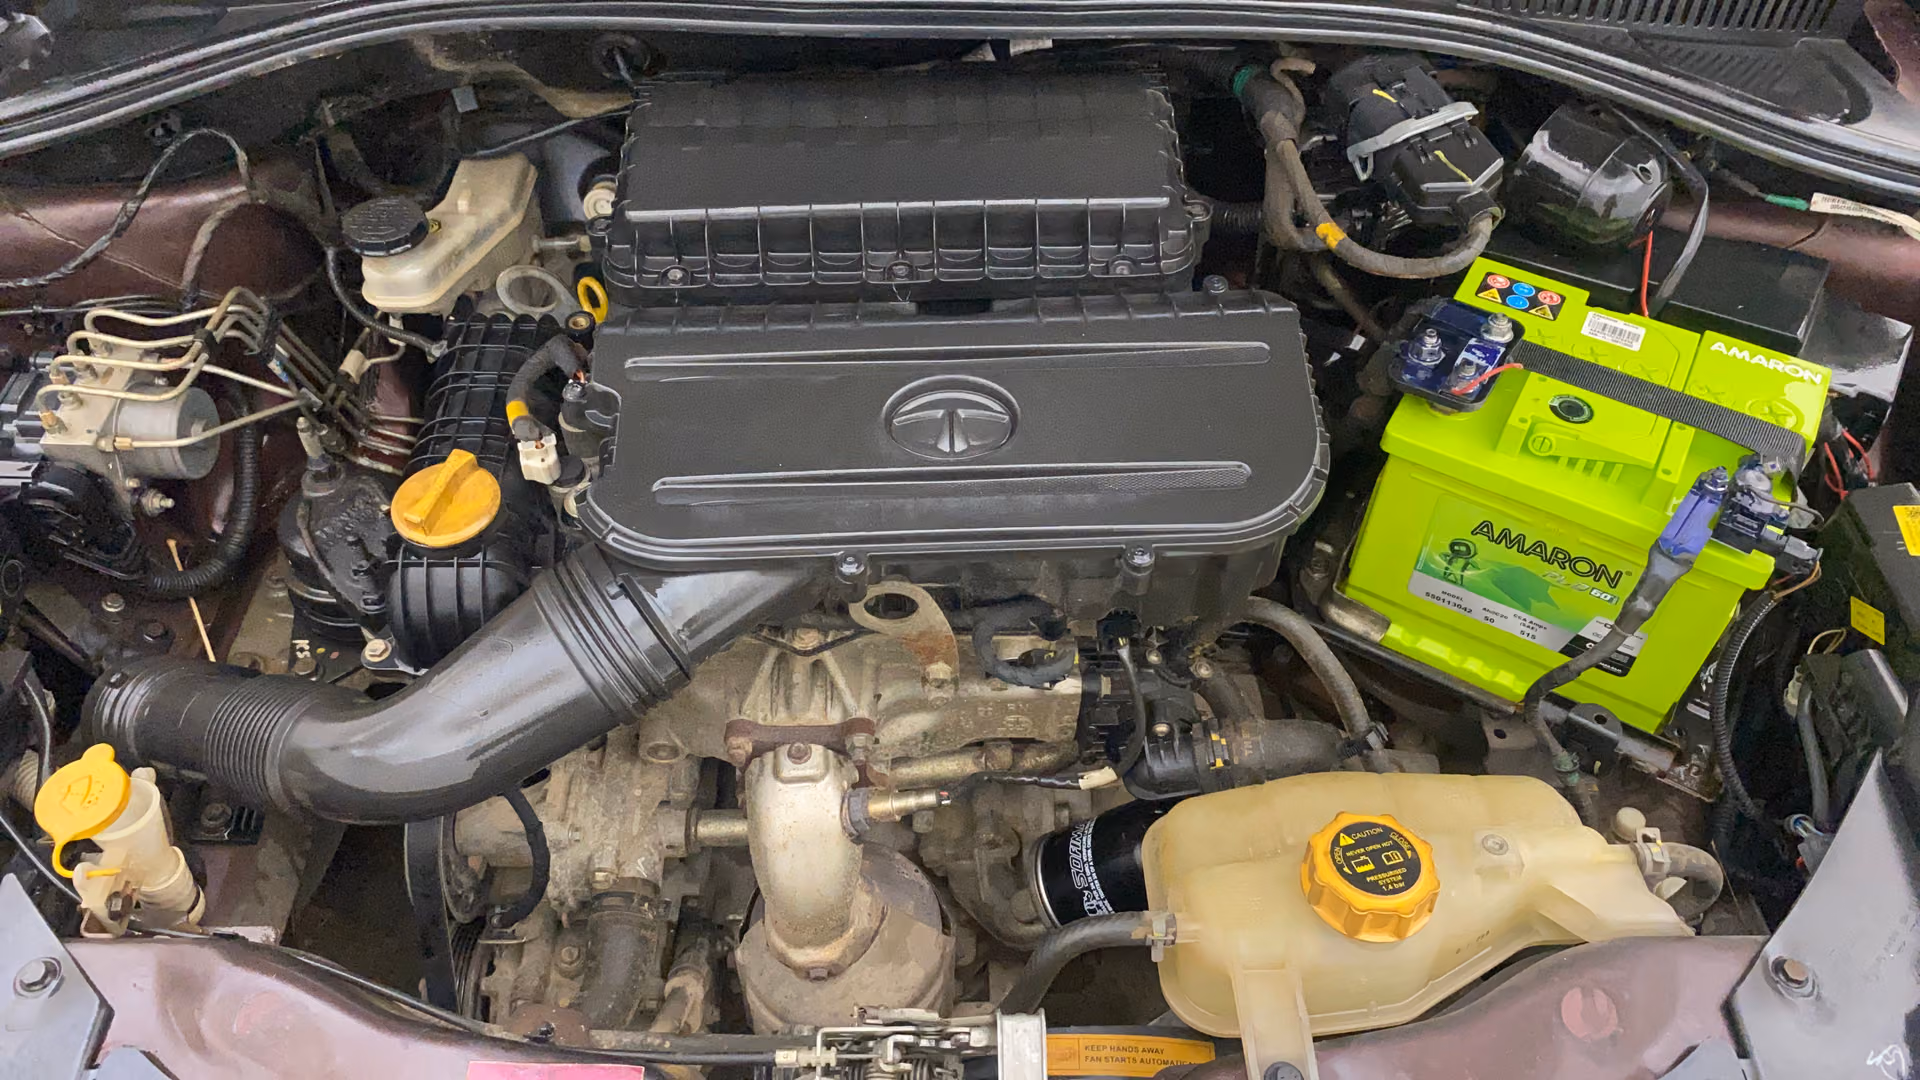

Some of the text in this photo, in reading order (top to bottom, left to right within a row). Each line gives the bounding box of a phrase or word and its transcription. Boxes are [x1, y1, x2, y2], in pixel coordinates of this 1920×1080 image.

[1710, 341, 1823, 385] AMARON
[1471, 520, 1623, 590] AMARON
[1483, 615, 1495, 624] 50
[1519, 629, 1537, 640] 515
[1351, 827, 1384, 840] CAUTION
[1389, 831, 1412, 849] CLOSE
[1346, 840, 1393, 856] NEVER OPEN HOT
[1333, 846, 1342, 864] OPEN
[1378, 875, 1403, 886] SYSTEM
[1393, 881, 1405, 889] bar
[1084, 1044, 1165, 1055] KEEP HANDS AWAY
[1084, 1055, 1197, 1066] FAN STARTS AUTOMATIC
